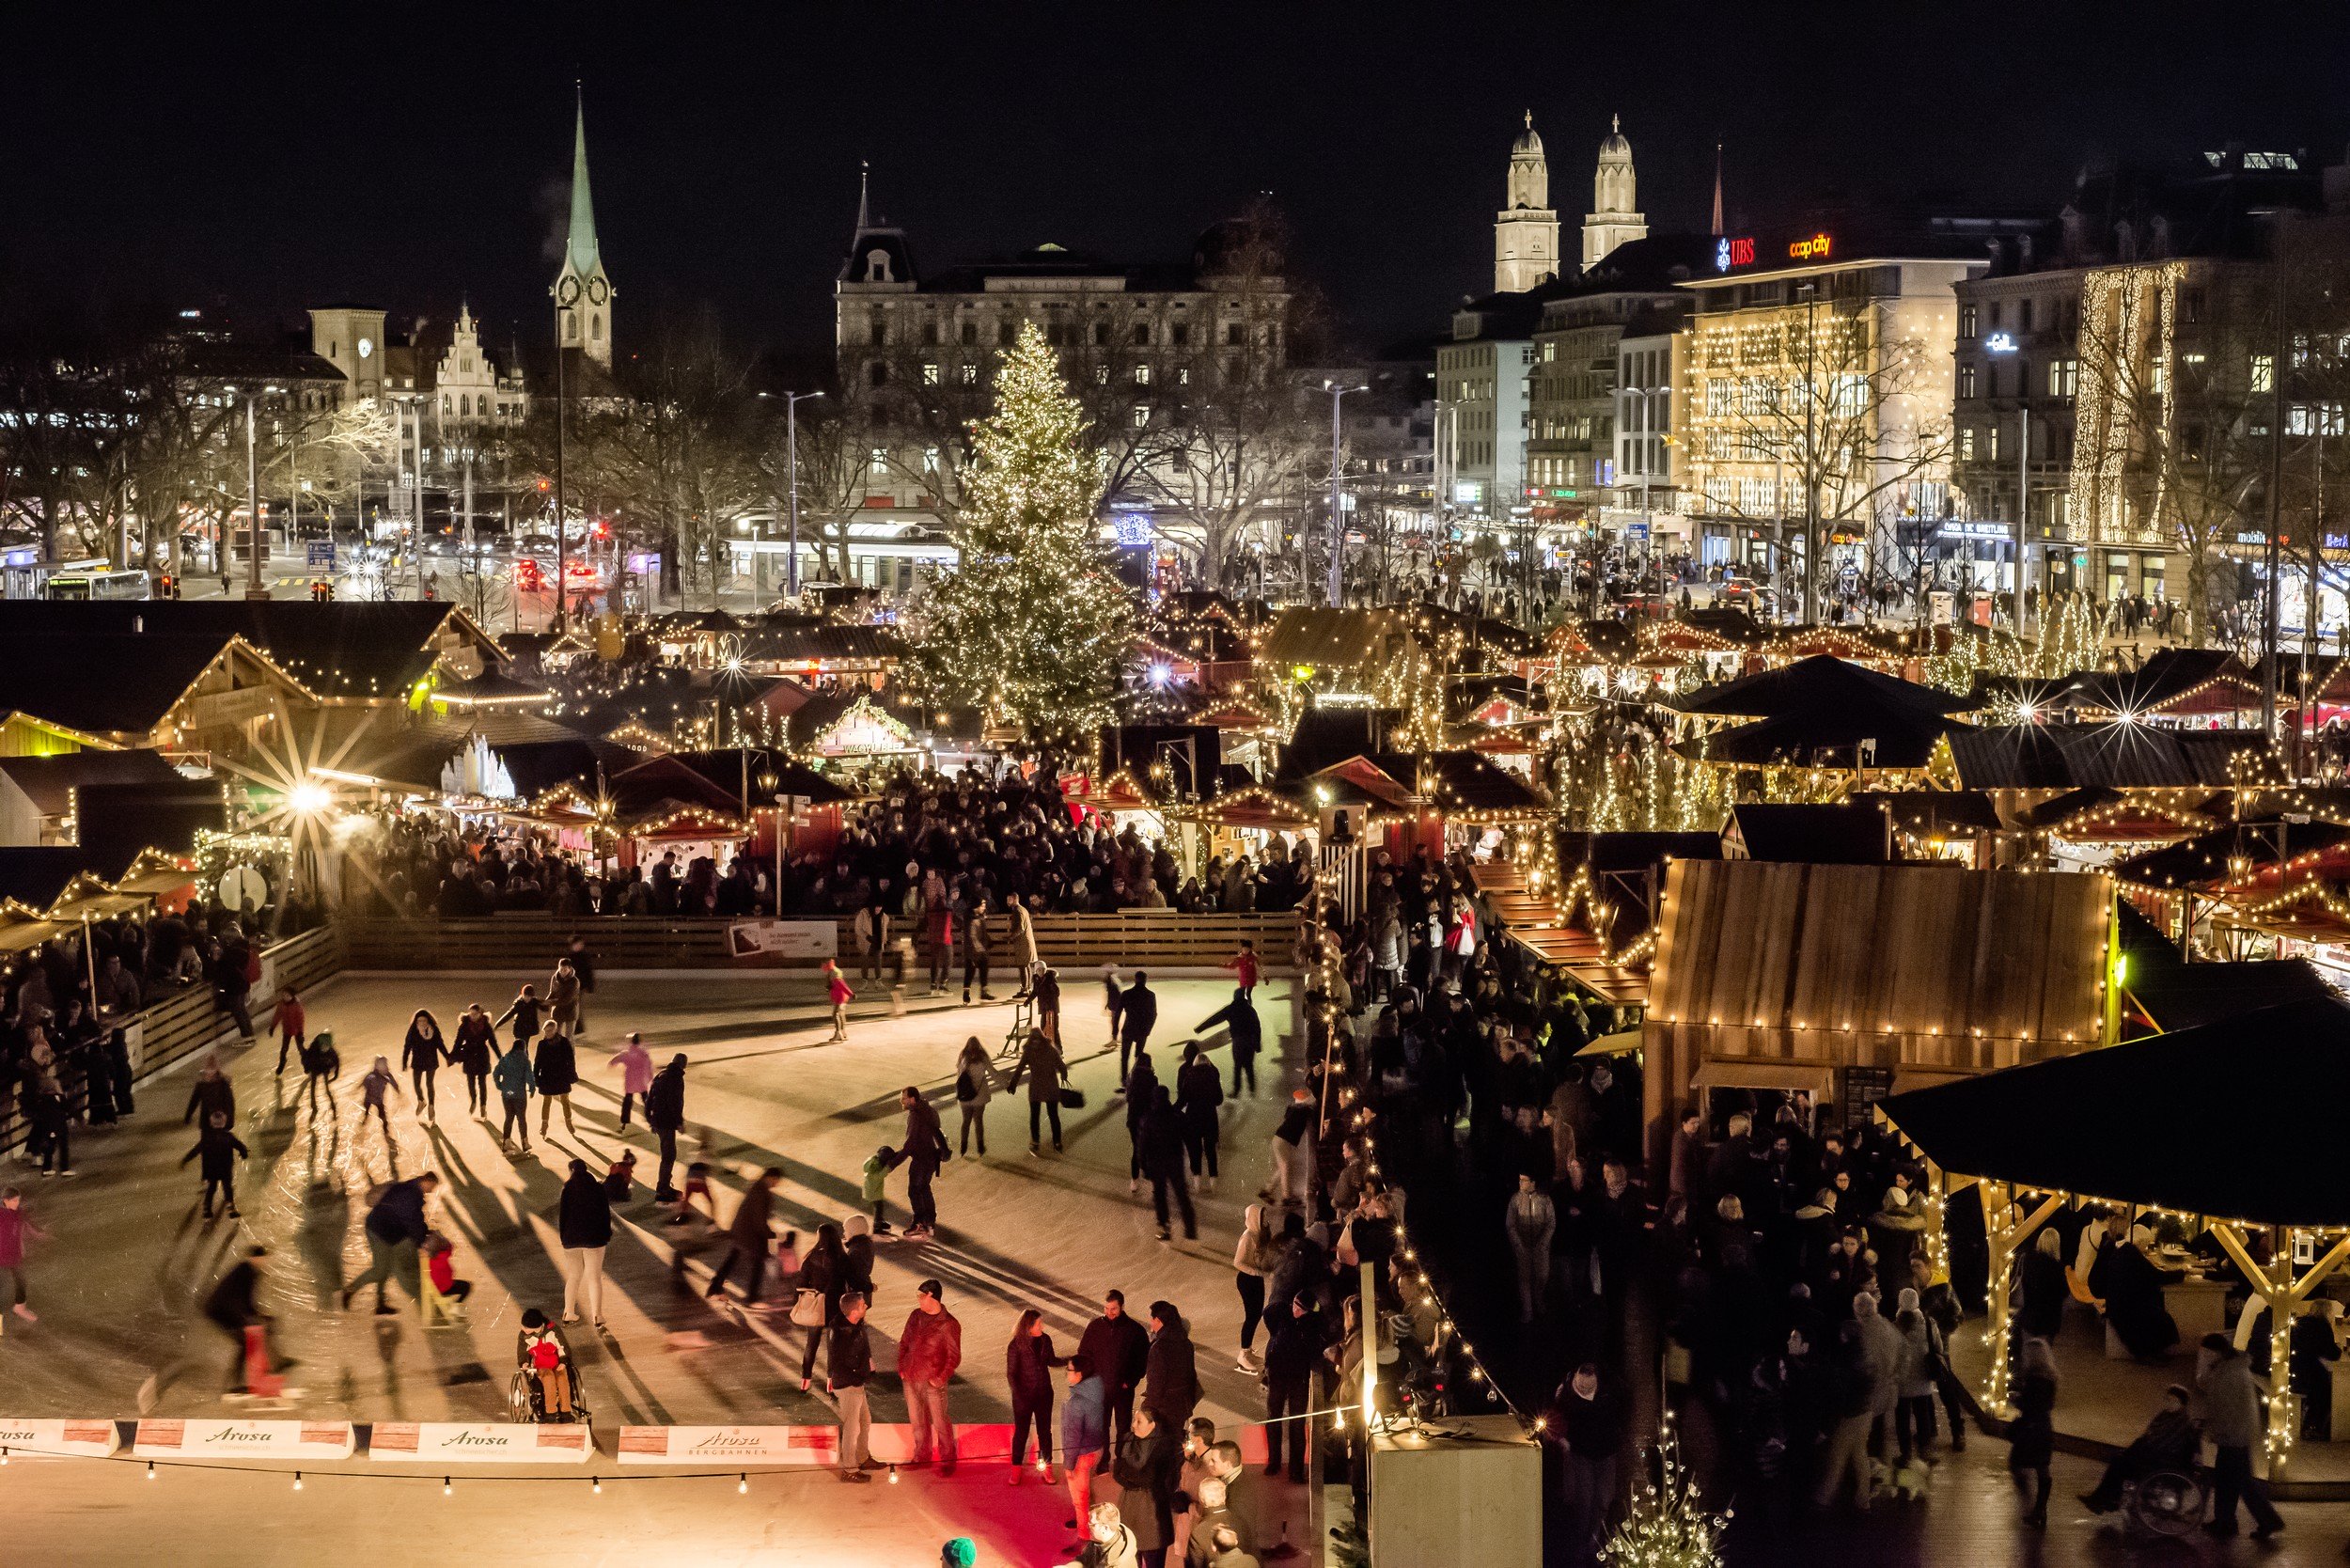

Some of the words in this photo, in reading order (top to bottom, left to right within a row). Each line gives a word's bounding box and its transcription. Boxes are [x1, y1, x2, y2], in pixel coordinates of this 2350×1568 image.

[1731, 238, 1754, 265] UBS
[1790, 242, 1811, 259] coop
[1812, 234, 1830, 255] city
[843, 745, 877, 753] WAGYU
[205, 1426, 273, 1442] Arosa
[441, 1431, 509, 1447] Arosa
[697, 1431, 760, 1448] Arosa
